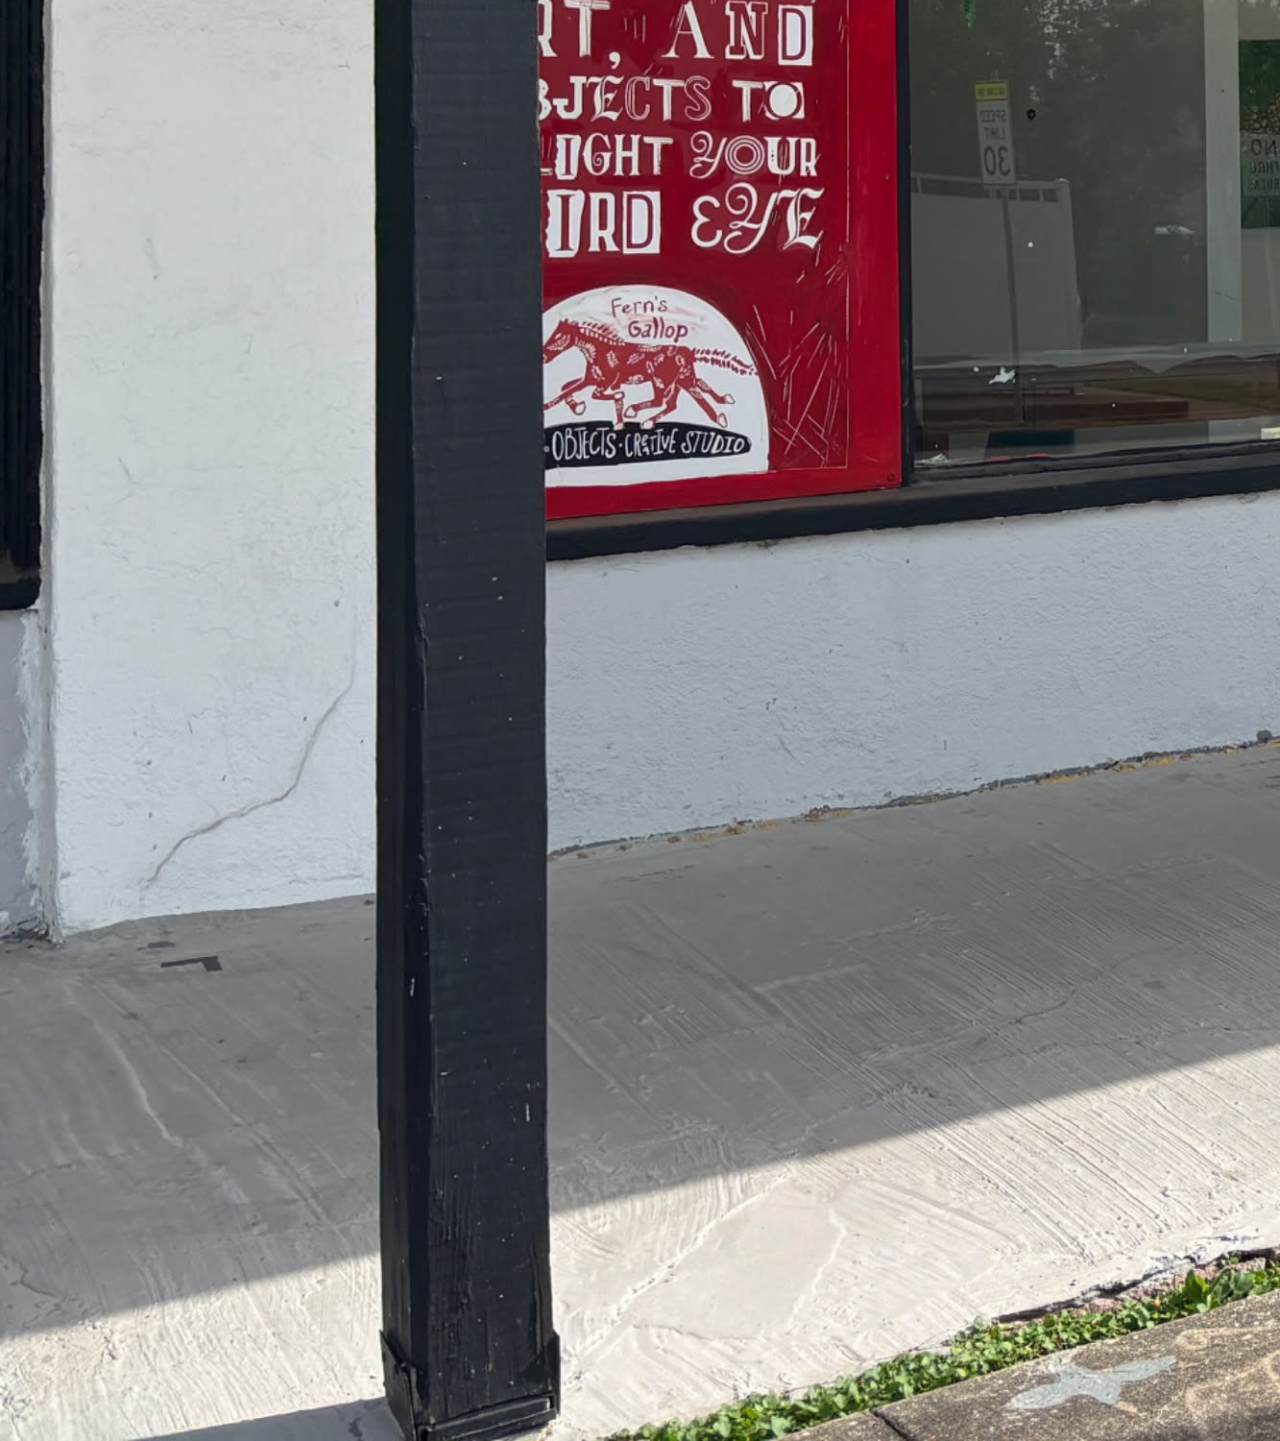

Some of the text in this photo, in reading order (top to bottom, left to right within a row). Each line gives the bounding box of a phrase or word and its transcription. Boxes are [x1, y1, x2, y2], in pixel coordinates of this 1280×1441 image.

[663, 0, 813, 66] AND
[732, 79, 805, 122] TO
[689, 131, 817, 179] YOUR
[547, 182, 824, 258] IRD EYE
[611, 296, 668, 316] Fern's
[628, 318, 688, 343] Gallop
[552, 426, 617, 460] OBJECTS
[680, 430, 745, 454] STUDIO
